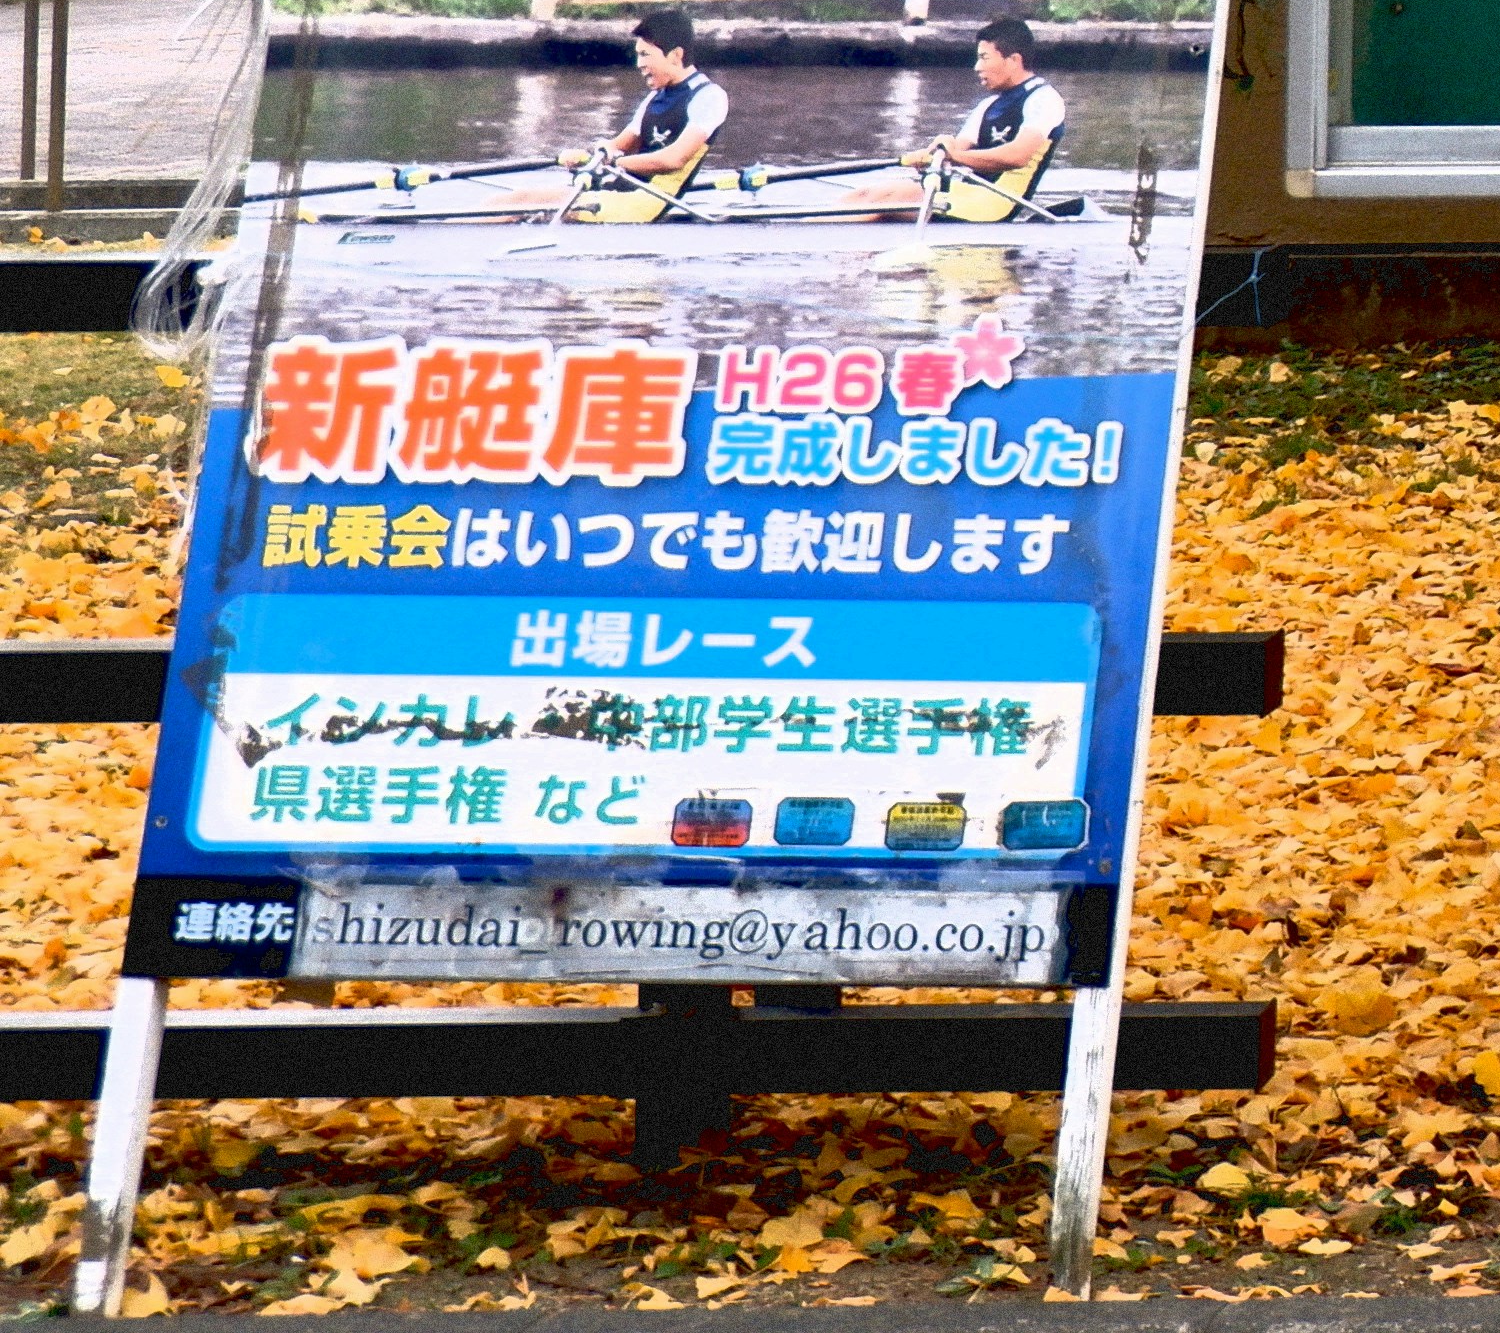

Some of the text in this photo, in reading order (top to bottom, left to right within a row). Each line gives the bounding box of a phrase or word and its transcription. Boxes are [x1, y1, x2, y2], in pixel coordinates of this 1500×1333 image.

[719, 350, 884, 410] H26
[257, 344, 688, 479] 新艇庫
[262, 503, 1072, 573] 試乗会はいつでも歓迎します
[509, 610, 816, 669] 出場レース
[250, 764, 646, 826] 県選手権 など
[175, 901, 293, 944] 連絡先
